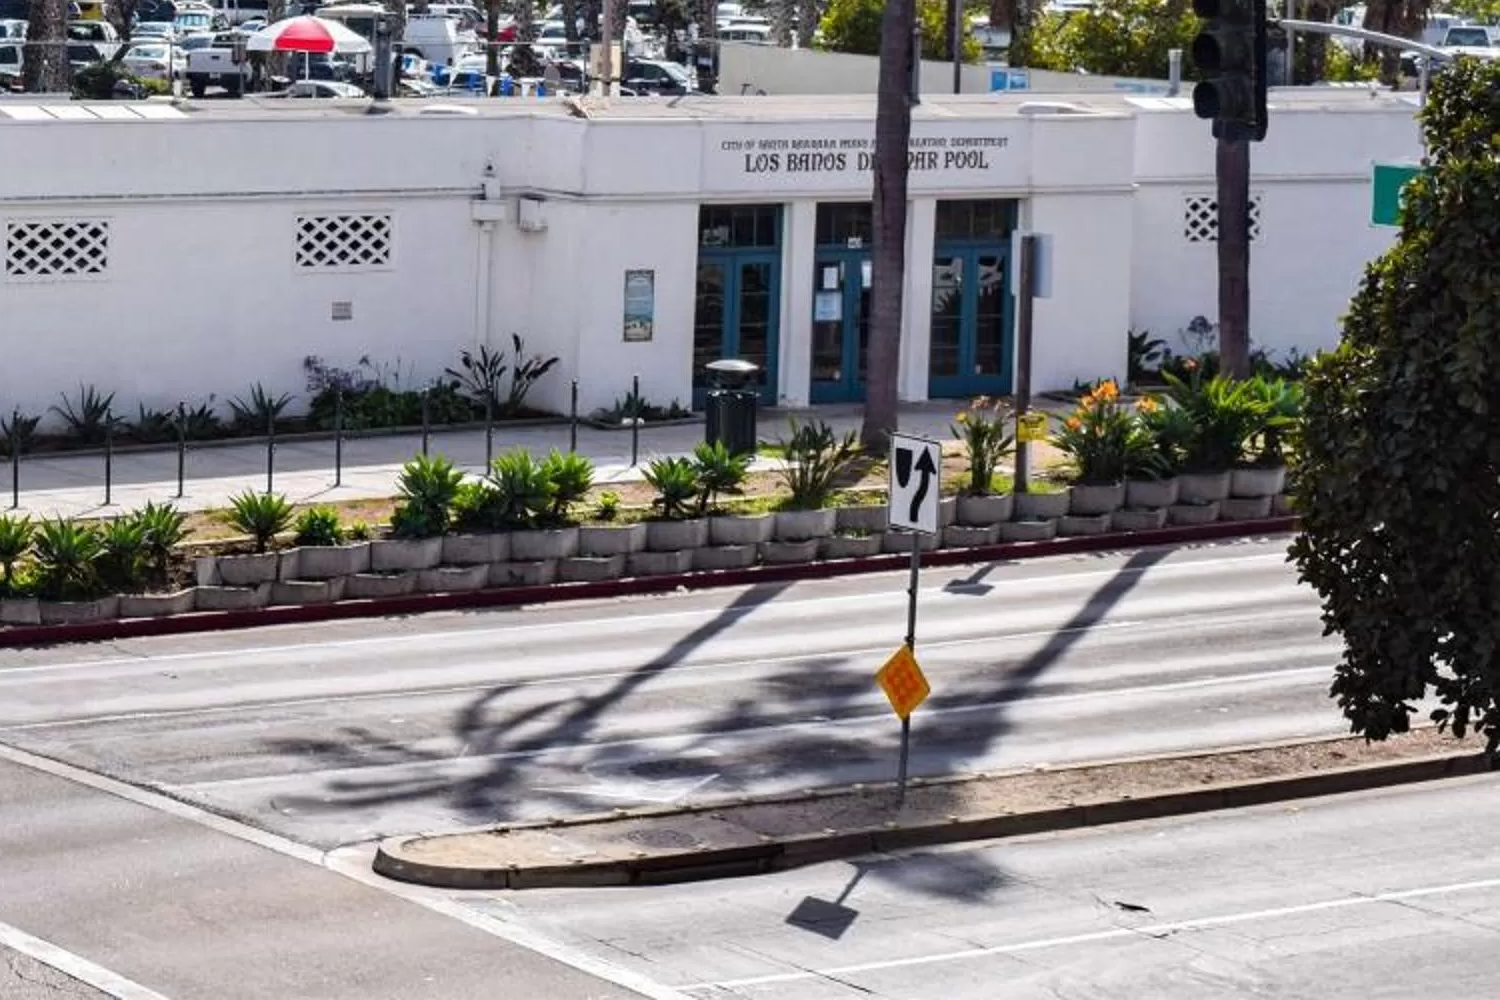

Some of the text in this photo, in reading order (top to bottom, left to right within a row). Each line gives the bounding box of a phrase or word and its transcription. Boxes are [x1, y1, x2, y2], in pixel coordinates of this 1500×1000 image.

[745, 152, 779, 173] LOS
[786, 152, 846, 172] BANOS
[944, 150, 989, 169] POOL
